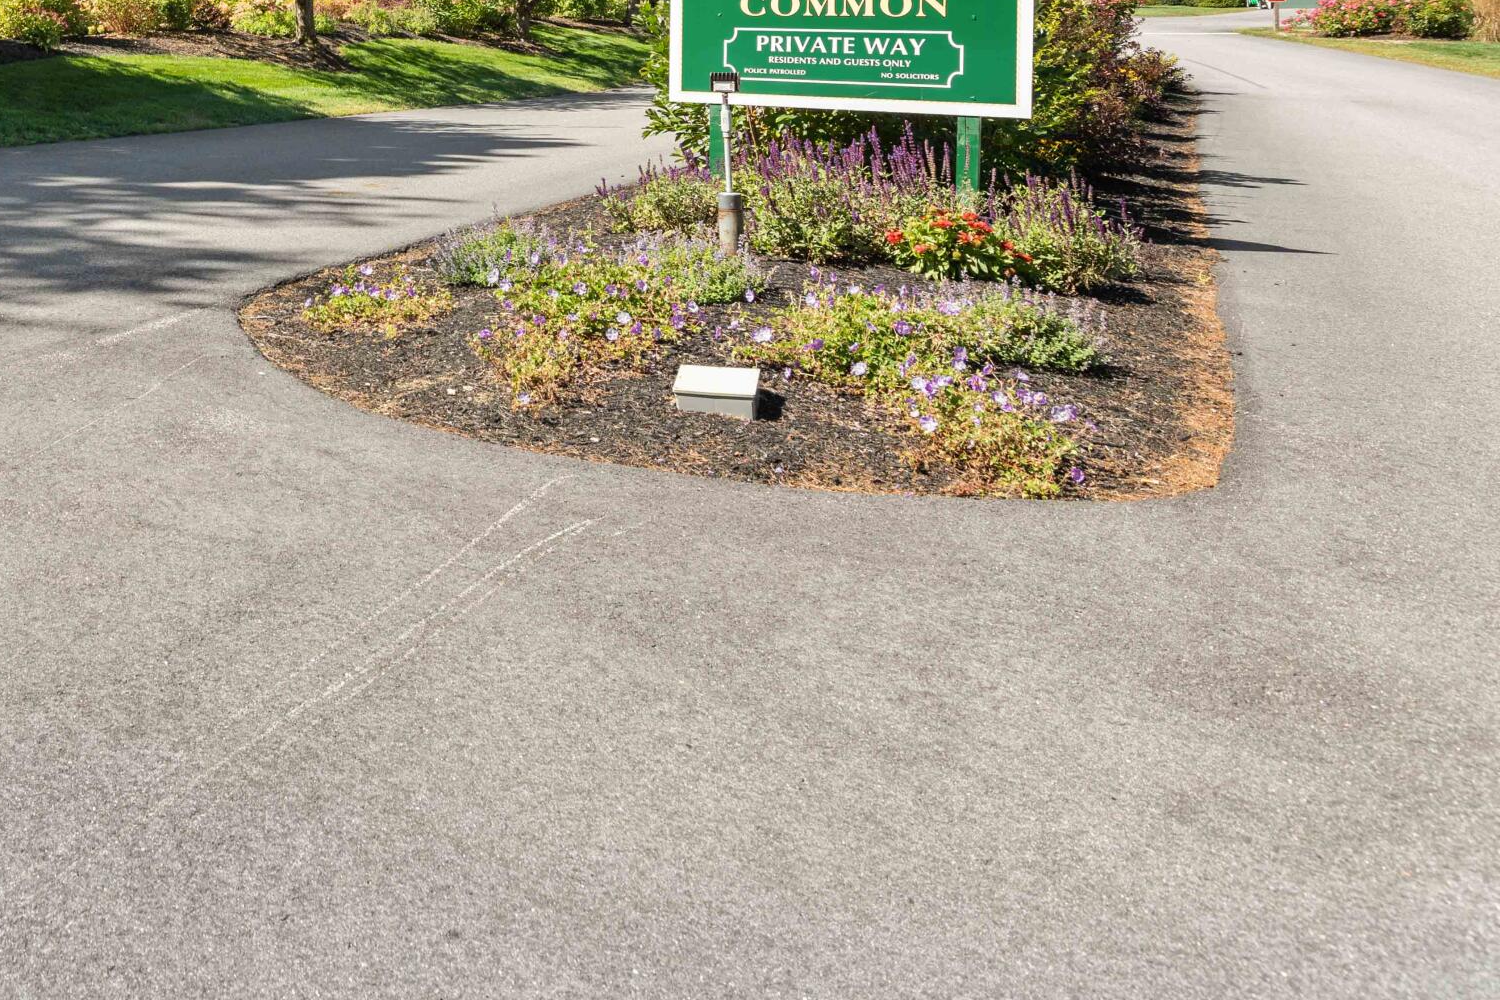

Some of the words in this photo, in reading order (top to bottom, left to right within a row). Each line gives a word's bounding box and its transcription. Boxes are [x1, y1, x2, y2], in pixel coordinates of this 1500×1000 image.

[756, 34, 856, 54] PRIVATE
[863, 37, 926, 56] WAY
[768, 56, 817, 65] RESIDENTS
[819, 57, 841, 66] AND
[843, 57, 880, 67] GUESTS
[882, 59, 912, 68] ONLY
[769, 68, 807, 76] PATROLLED
